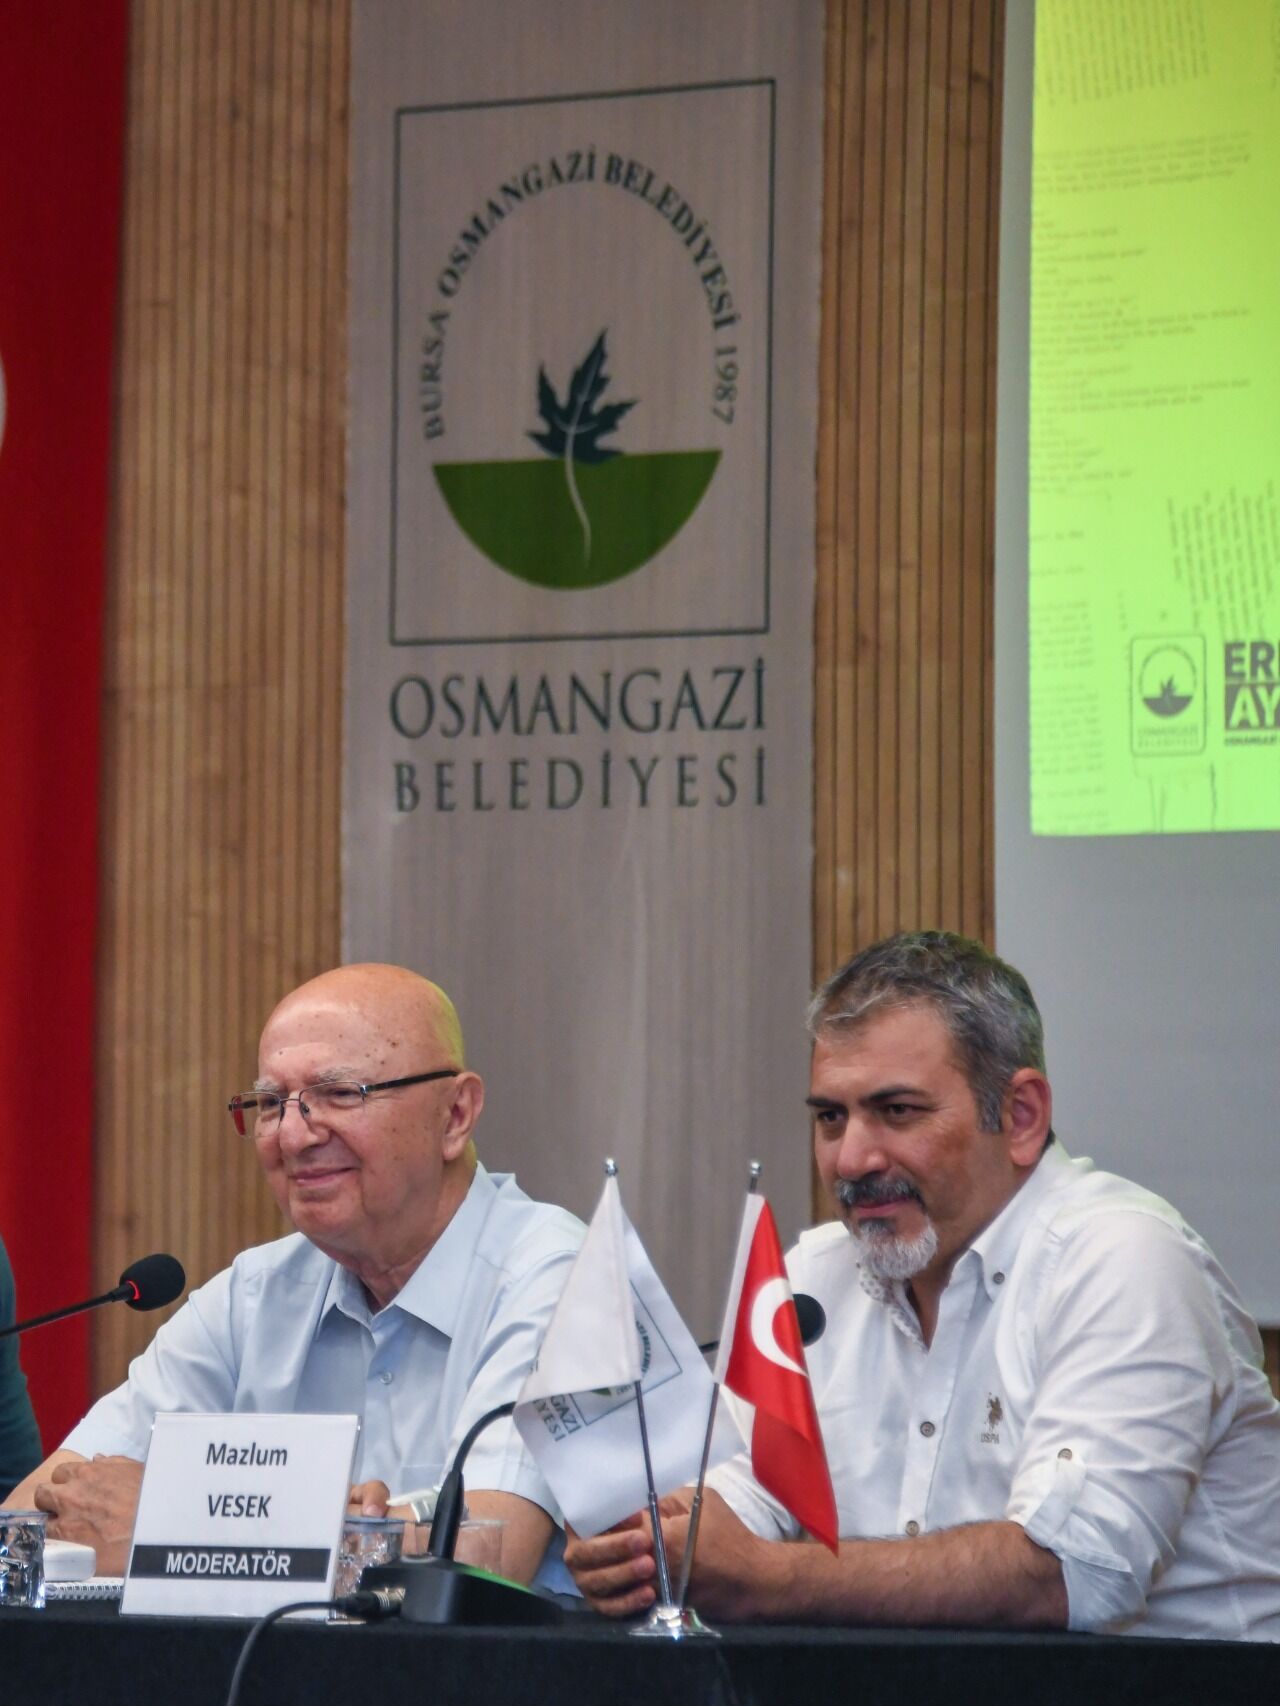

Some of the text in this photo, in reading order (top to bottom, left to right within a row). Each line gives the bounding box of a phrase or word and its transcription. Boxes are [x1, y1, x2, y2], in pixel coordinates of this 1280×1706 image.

[421, 310, 450, 440] BURSA
[437, 145, 597, 298] OSMANGAZİ
[714, 345, 738, 425] 1987
[1223, 640, 1280, 680] ER
[389, 657, 766, 739] OSMANGAZİ
[393, 746, 766, 812] BELEDİYESİ
[206, 1442, 288, 1467] Mazlum
[207, 1494, 272, 1518] VESEK
[165, 1550, 291, 1577] MODERATÖR
